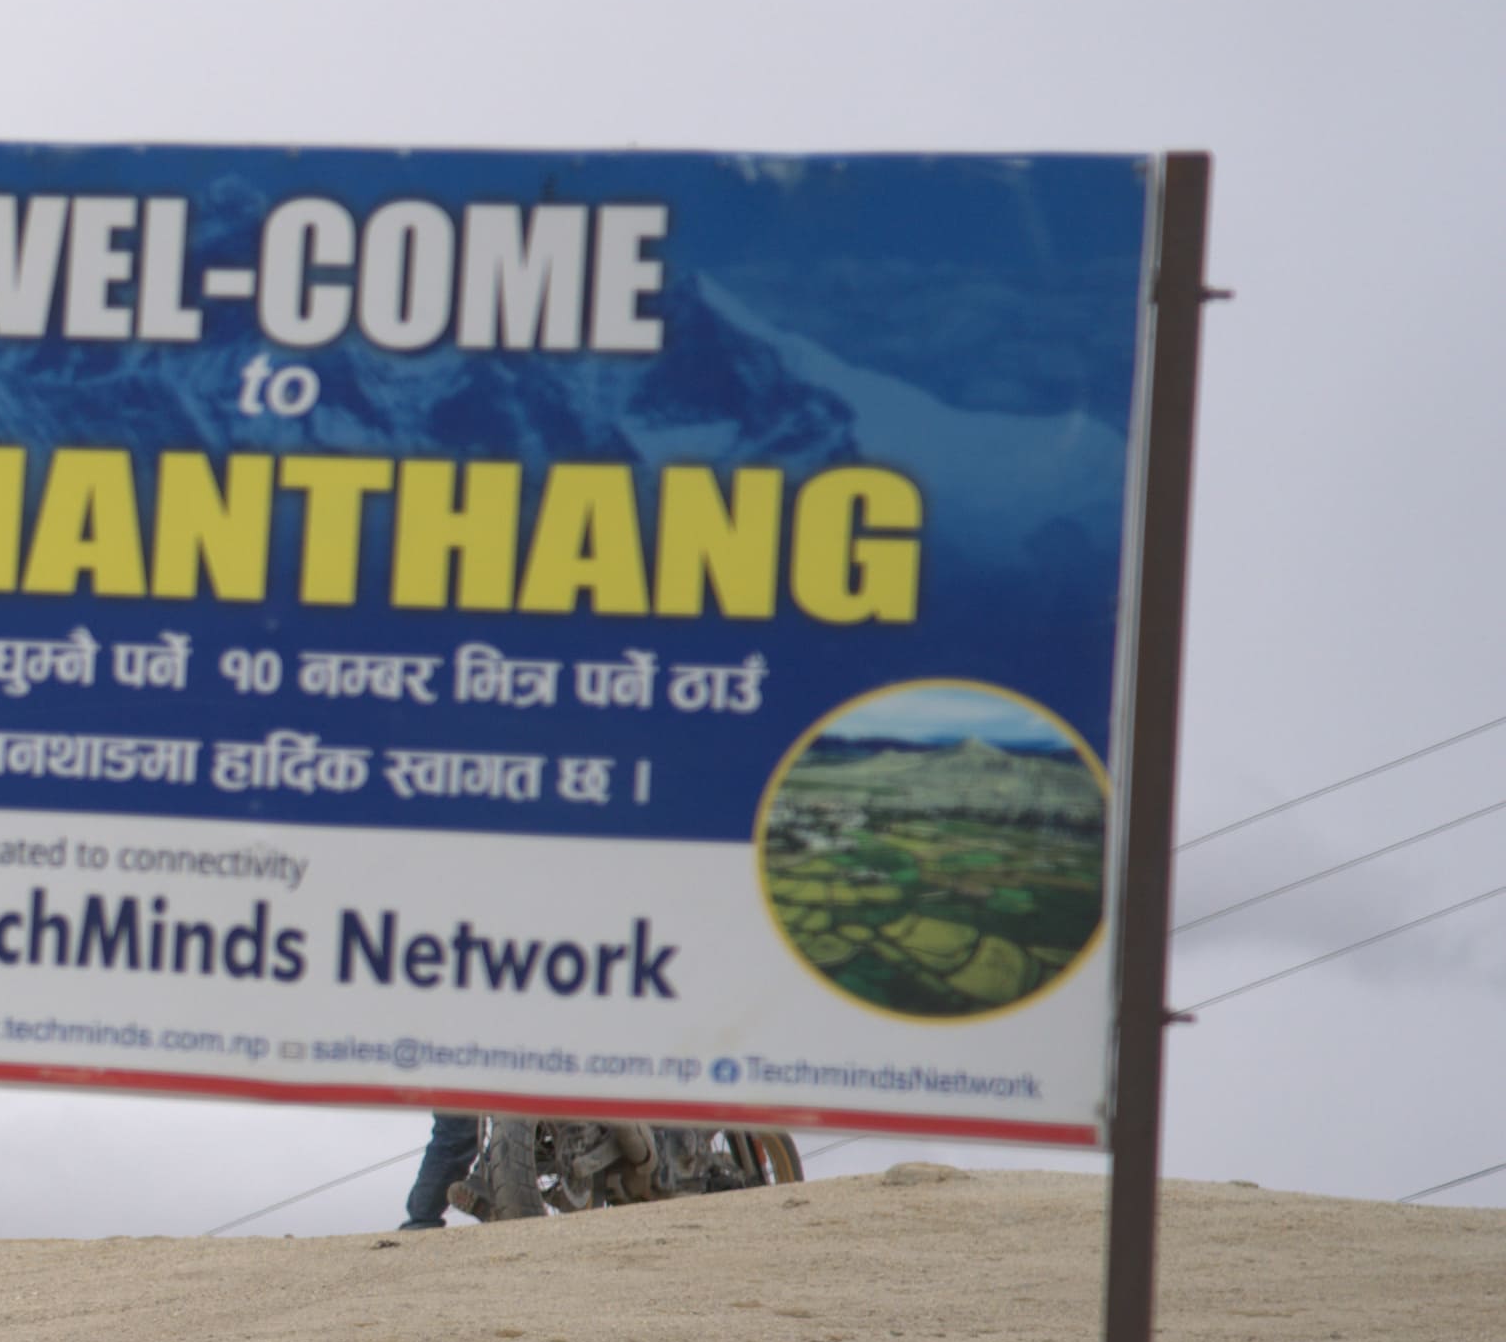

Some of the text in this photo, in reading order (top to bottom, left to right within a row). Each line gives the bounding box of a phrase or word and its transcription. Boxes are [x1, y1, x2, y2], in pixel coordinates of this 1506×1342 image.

[239, 354, 321, 416] to
[112, 630, 192, 689] पर्ने
[220, 649, 283, 694] १०
[298, 652, 443, 703] नम्बर
[455, 643, 562, 707] भित्र
[574, 650, 658, 709] पर्ने
[386, 749, 547, 801] स्वागत
[556, 758, 616, 804] छ
[77, 843, 109, 871] to
[118, 844, 308, 890] connectivity
[337, 908, 680, 1000] Network
[311, 1035, 703, 1082] sales@techminds.com.np
